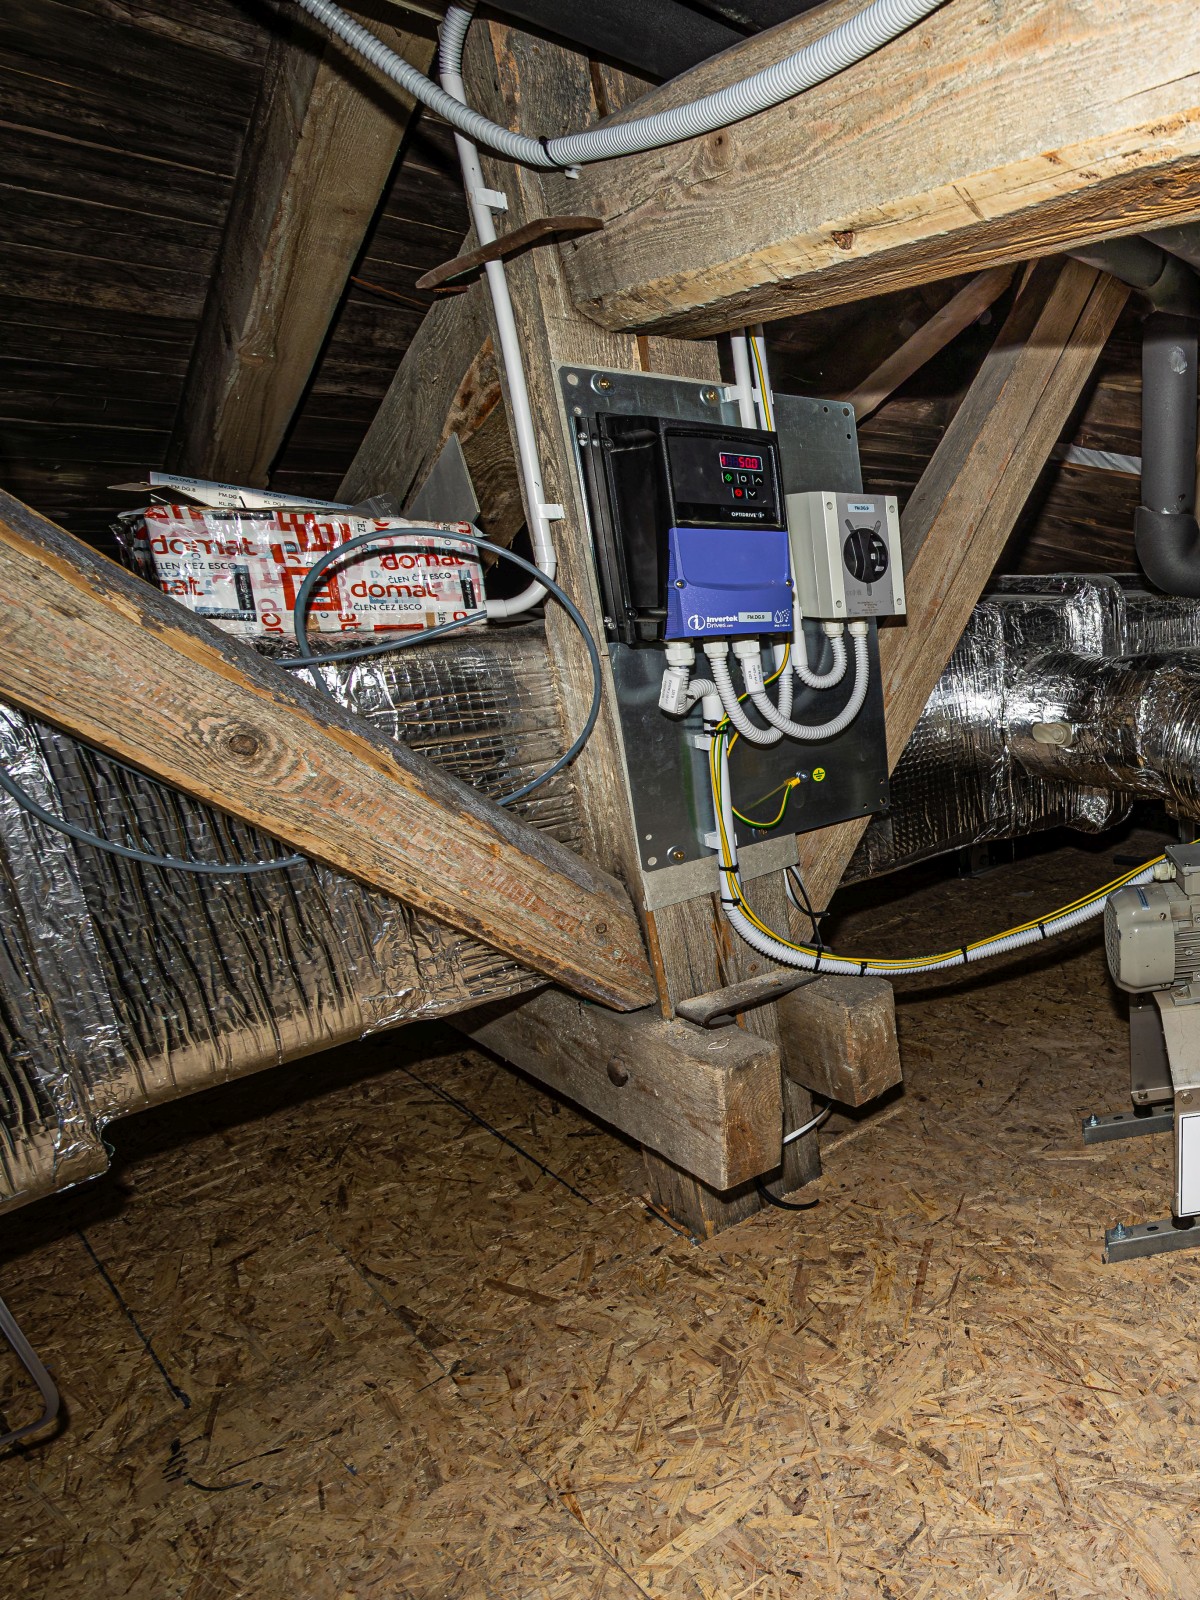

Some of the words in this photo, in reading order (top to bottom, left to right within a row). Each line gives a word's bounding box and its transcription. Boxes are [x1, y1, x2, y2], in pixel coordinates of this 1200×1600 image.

[151, 535, 259, 556] domat
[208, 562, 238, 570] ESCO
[382, 549, 466, 571] domat
[387, 574, 410, 584] ČLEN
[429, 572, 452, 581] ESCO
[350, 580, 439, 598] domat
[353, 603, 377, 611] ČLEN
[379, 603, 396, 611] ČEZ
[398, 603, 422, 611] ESCO
[706, 615, 738, 623] Invertek
